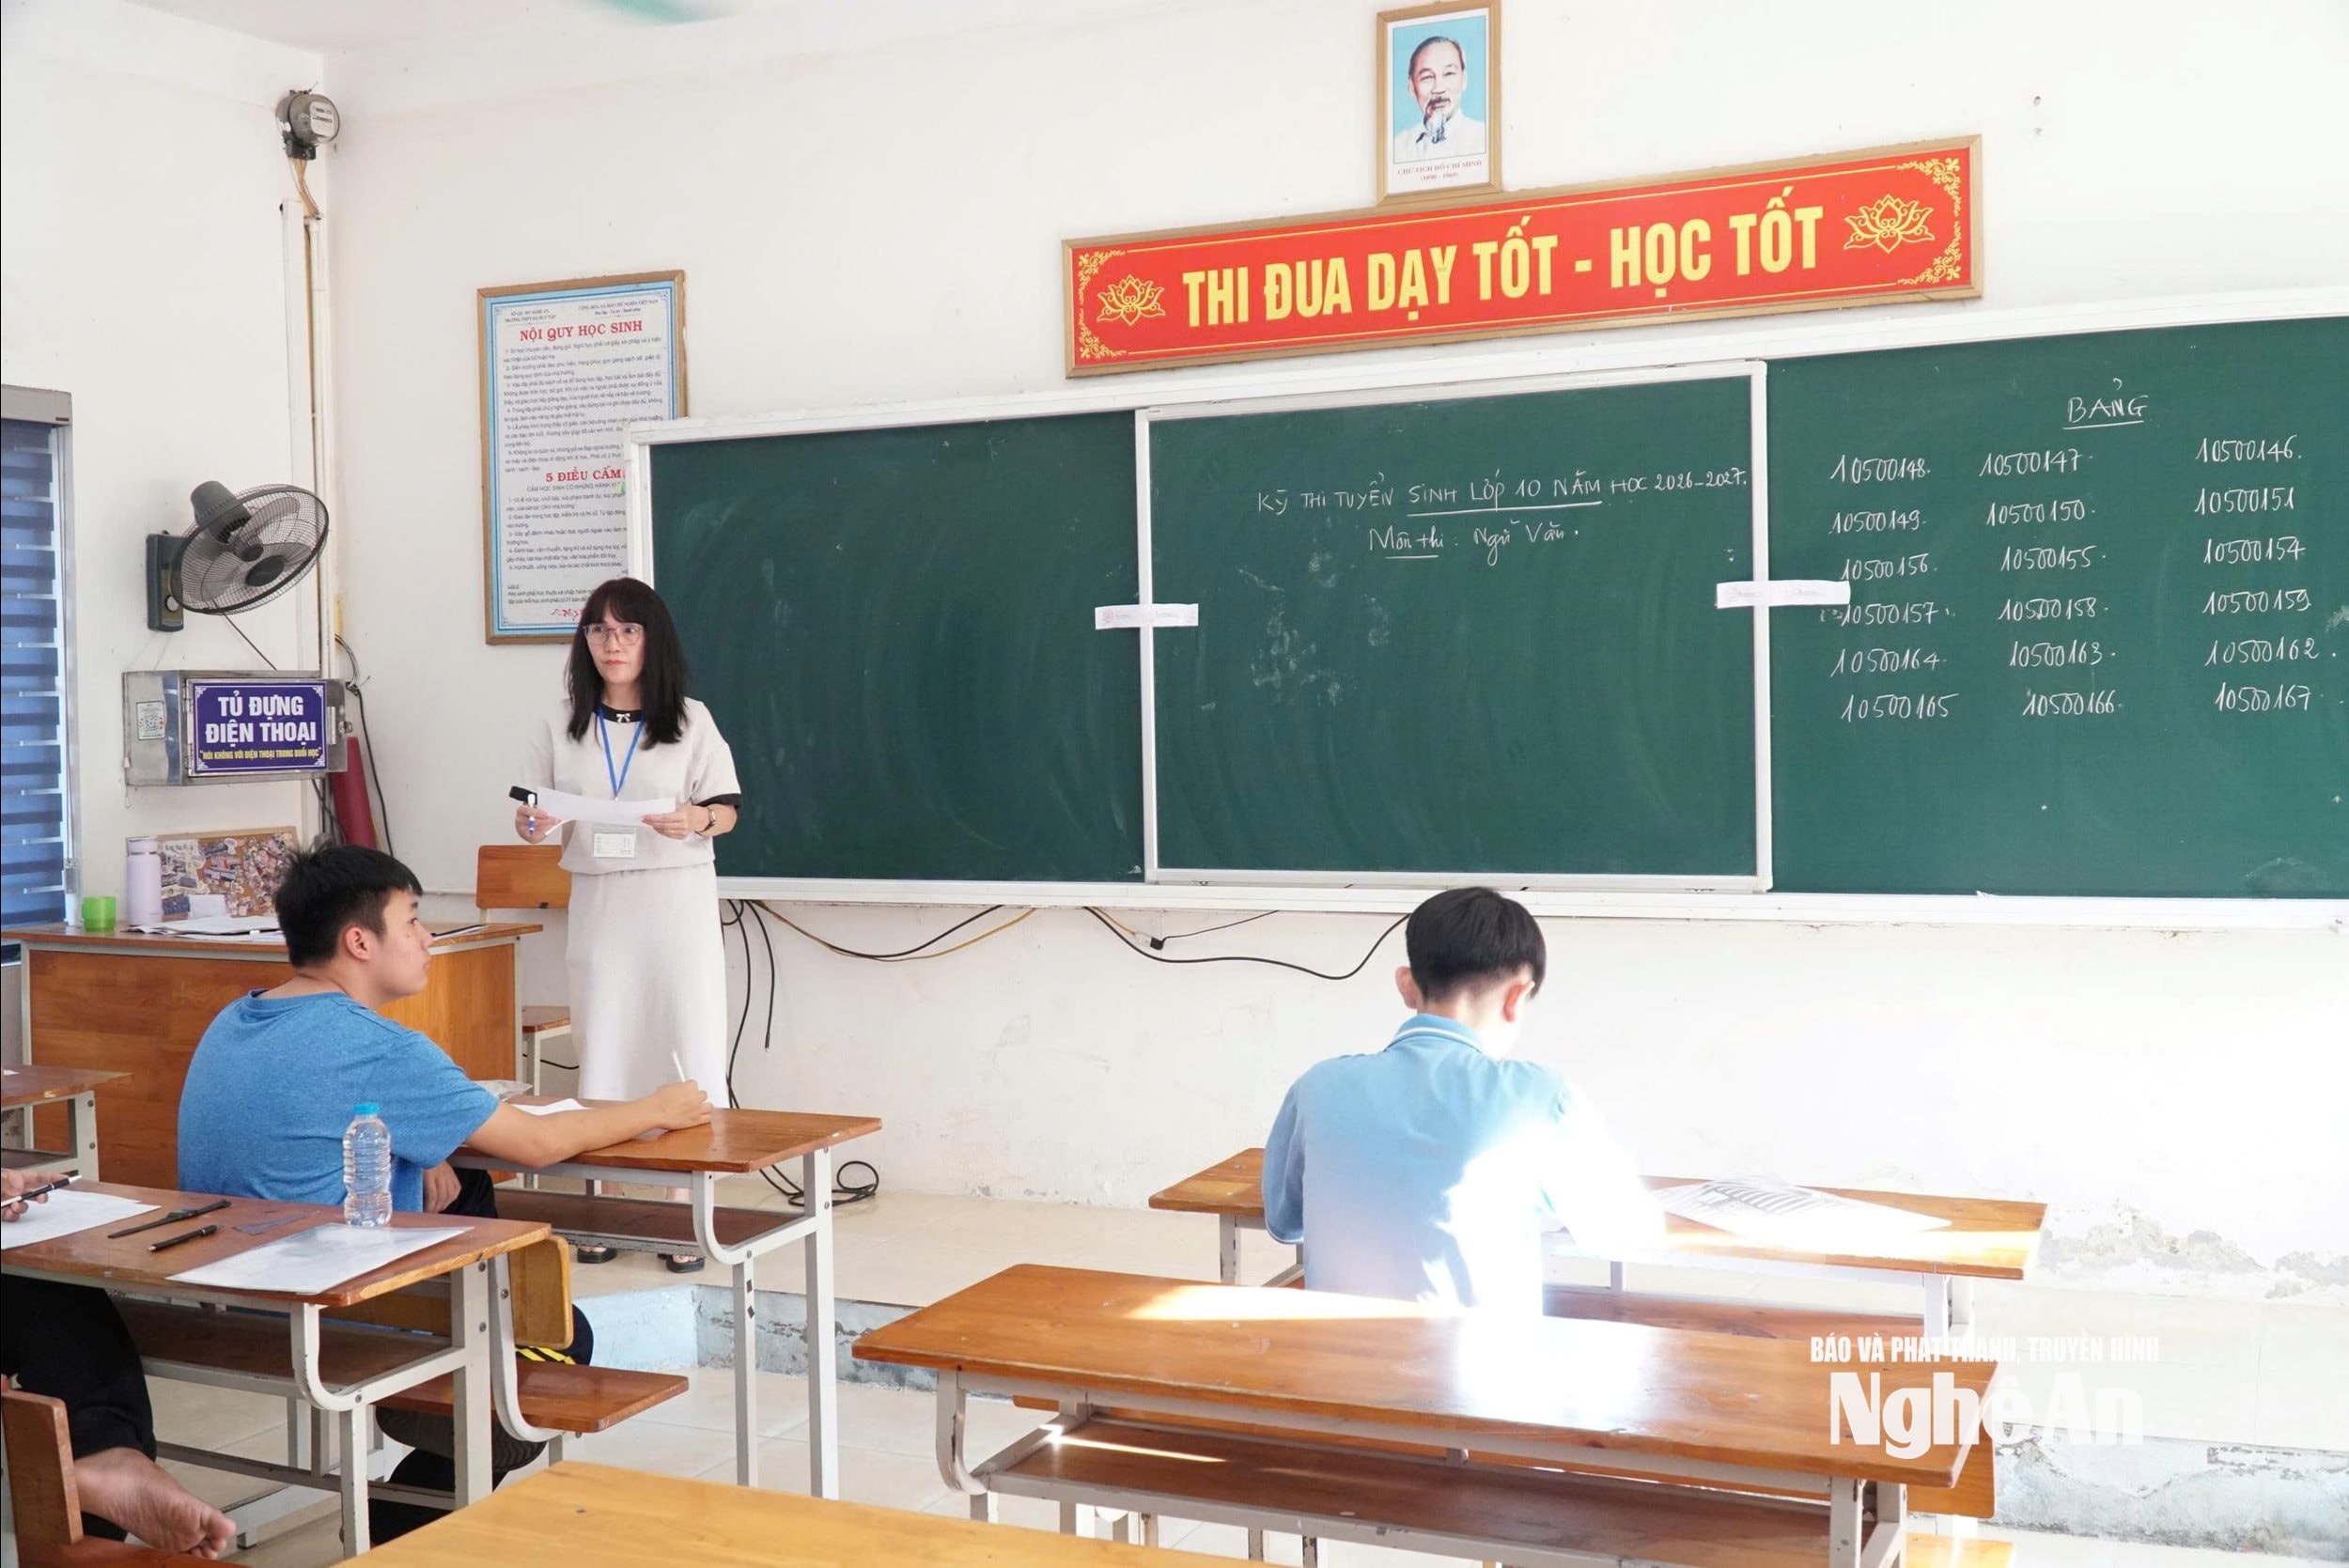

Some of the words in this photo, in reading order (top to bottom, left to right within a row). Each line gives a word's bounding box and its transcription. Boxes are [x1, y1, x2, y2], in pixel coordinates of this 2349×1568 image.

[1182, 266, 1250, 328] THI
[1263, 256, 1353, 321] ĐUA
[1367, 244, 1458, 321] DẠY
[1471, 215, 1559, 302] TỐT
[1574, 258, 1593, 273] -
[1610, 218, 1712, 299] HỌC
[1728, 185, 1824, 277] TỐT
[520, 327, 543, 342] NỘI
[547, 326, 573, 342] QUY
[578, 323, 606, 338] HỌC
[610, 320, 643, 334] SINH
[2066, 377, 2149, 423] BẢNG
[546, 473, 553, 482] 5
[557, 466, 588, 482] ĐIỀU
[592, 466, 621, 480] CẤM
[1333, 472, 1394, 511] TUYỂN
[1515, 478, 1542, 498] 10
[1553, 469, 1601, 498] NĂM
[2194, 486, 2295, 517] 10500151
[1368, 524, 1412, 551] Môn
[2202, 535, 2307, 565] 10500154
[217, 690, 244, 718] TỦ
[248, 693, 304, 720] ĐỰNG
[1840, 692, 1960, 723] 10500165
[2214, 681, 2312, 713] 10500167
[204, 719, 255, 747] ĐIỆN
[258, 722, 317, 746] THOẠI
